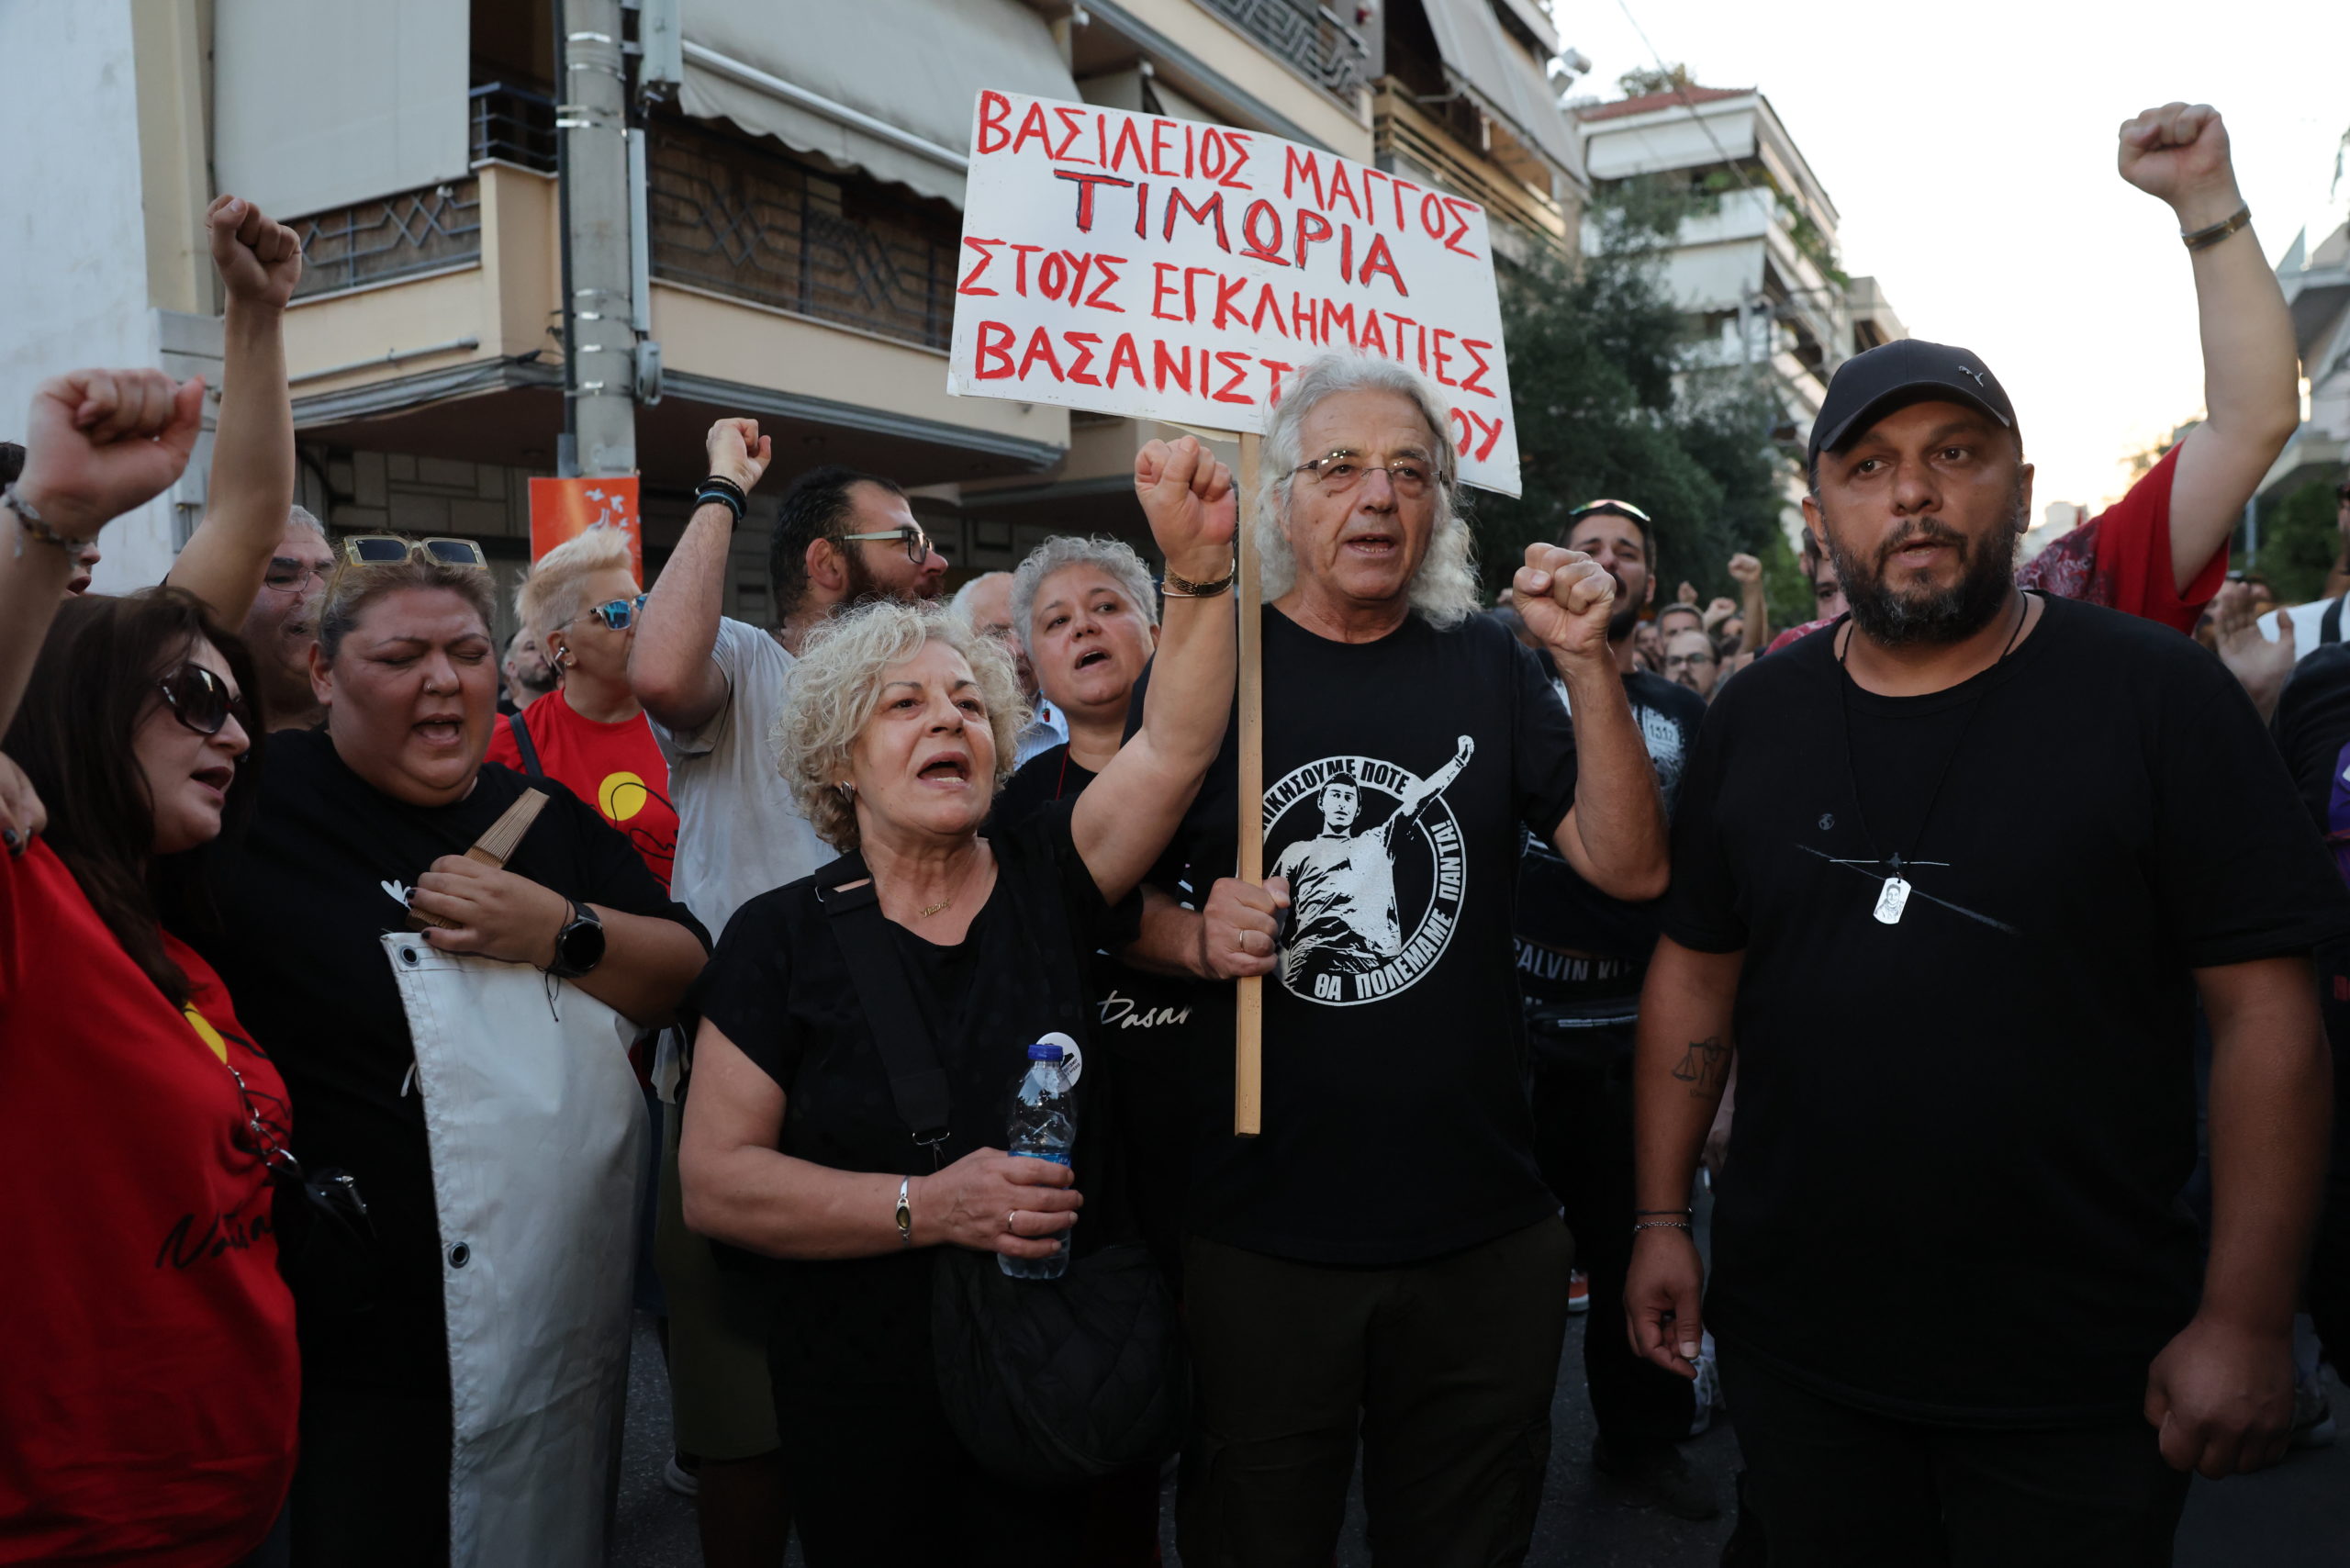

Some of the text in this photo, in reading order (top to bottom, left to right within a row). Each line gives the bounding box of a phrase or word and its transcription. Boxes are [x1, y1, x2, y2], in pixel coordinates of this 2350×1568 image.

[978, 89, 1480, 260] ΒΑΣΙΛΕΙΟΣ ΜΑΓΓΟΣ
[1053, 169, 1408, 297] ΤΙΜΩΡΙΑ
[957, 236, 1496, 398] ΣΤΟΥΣ ΕΓΚΛΗΜΑΤΙΕΣ
[975, 320, 1504, 463] ΒΑΣΑΝΙΣΤ ΟΥ
[1360, 761, 1410, 795] ΠΟΤΕ
[1314, 818, 1462, 1002] ΘΑ ΠΟΛΕΜΑΜΕ ΠΑΝΤΑ!
